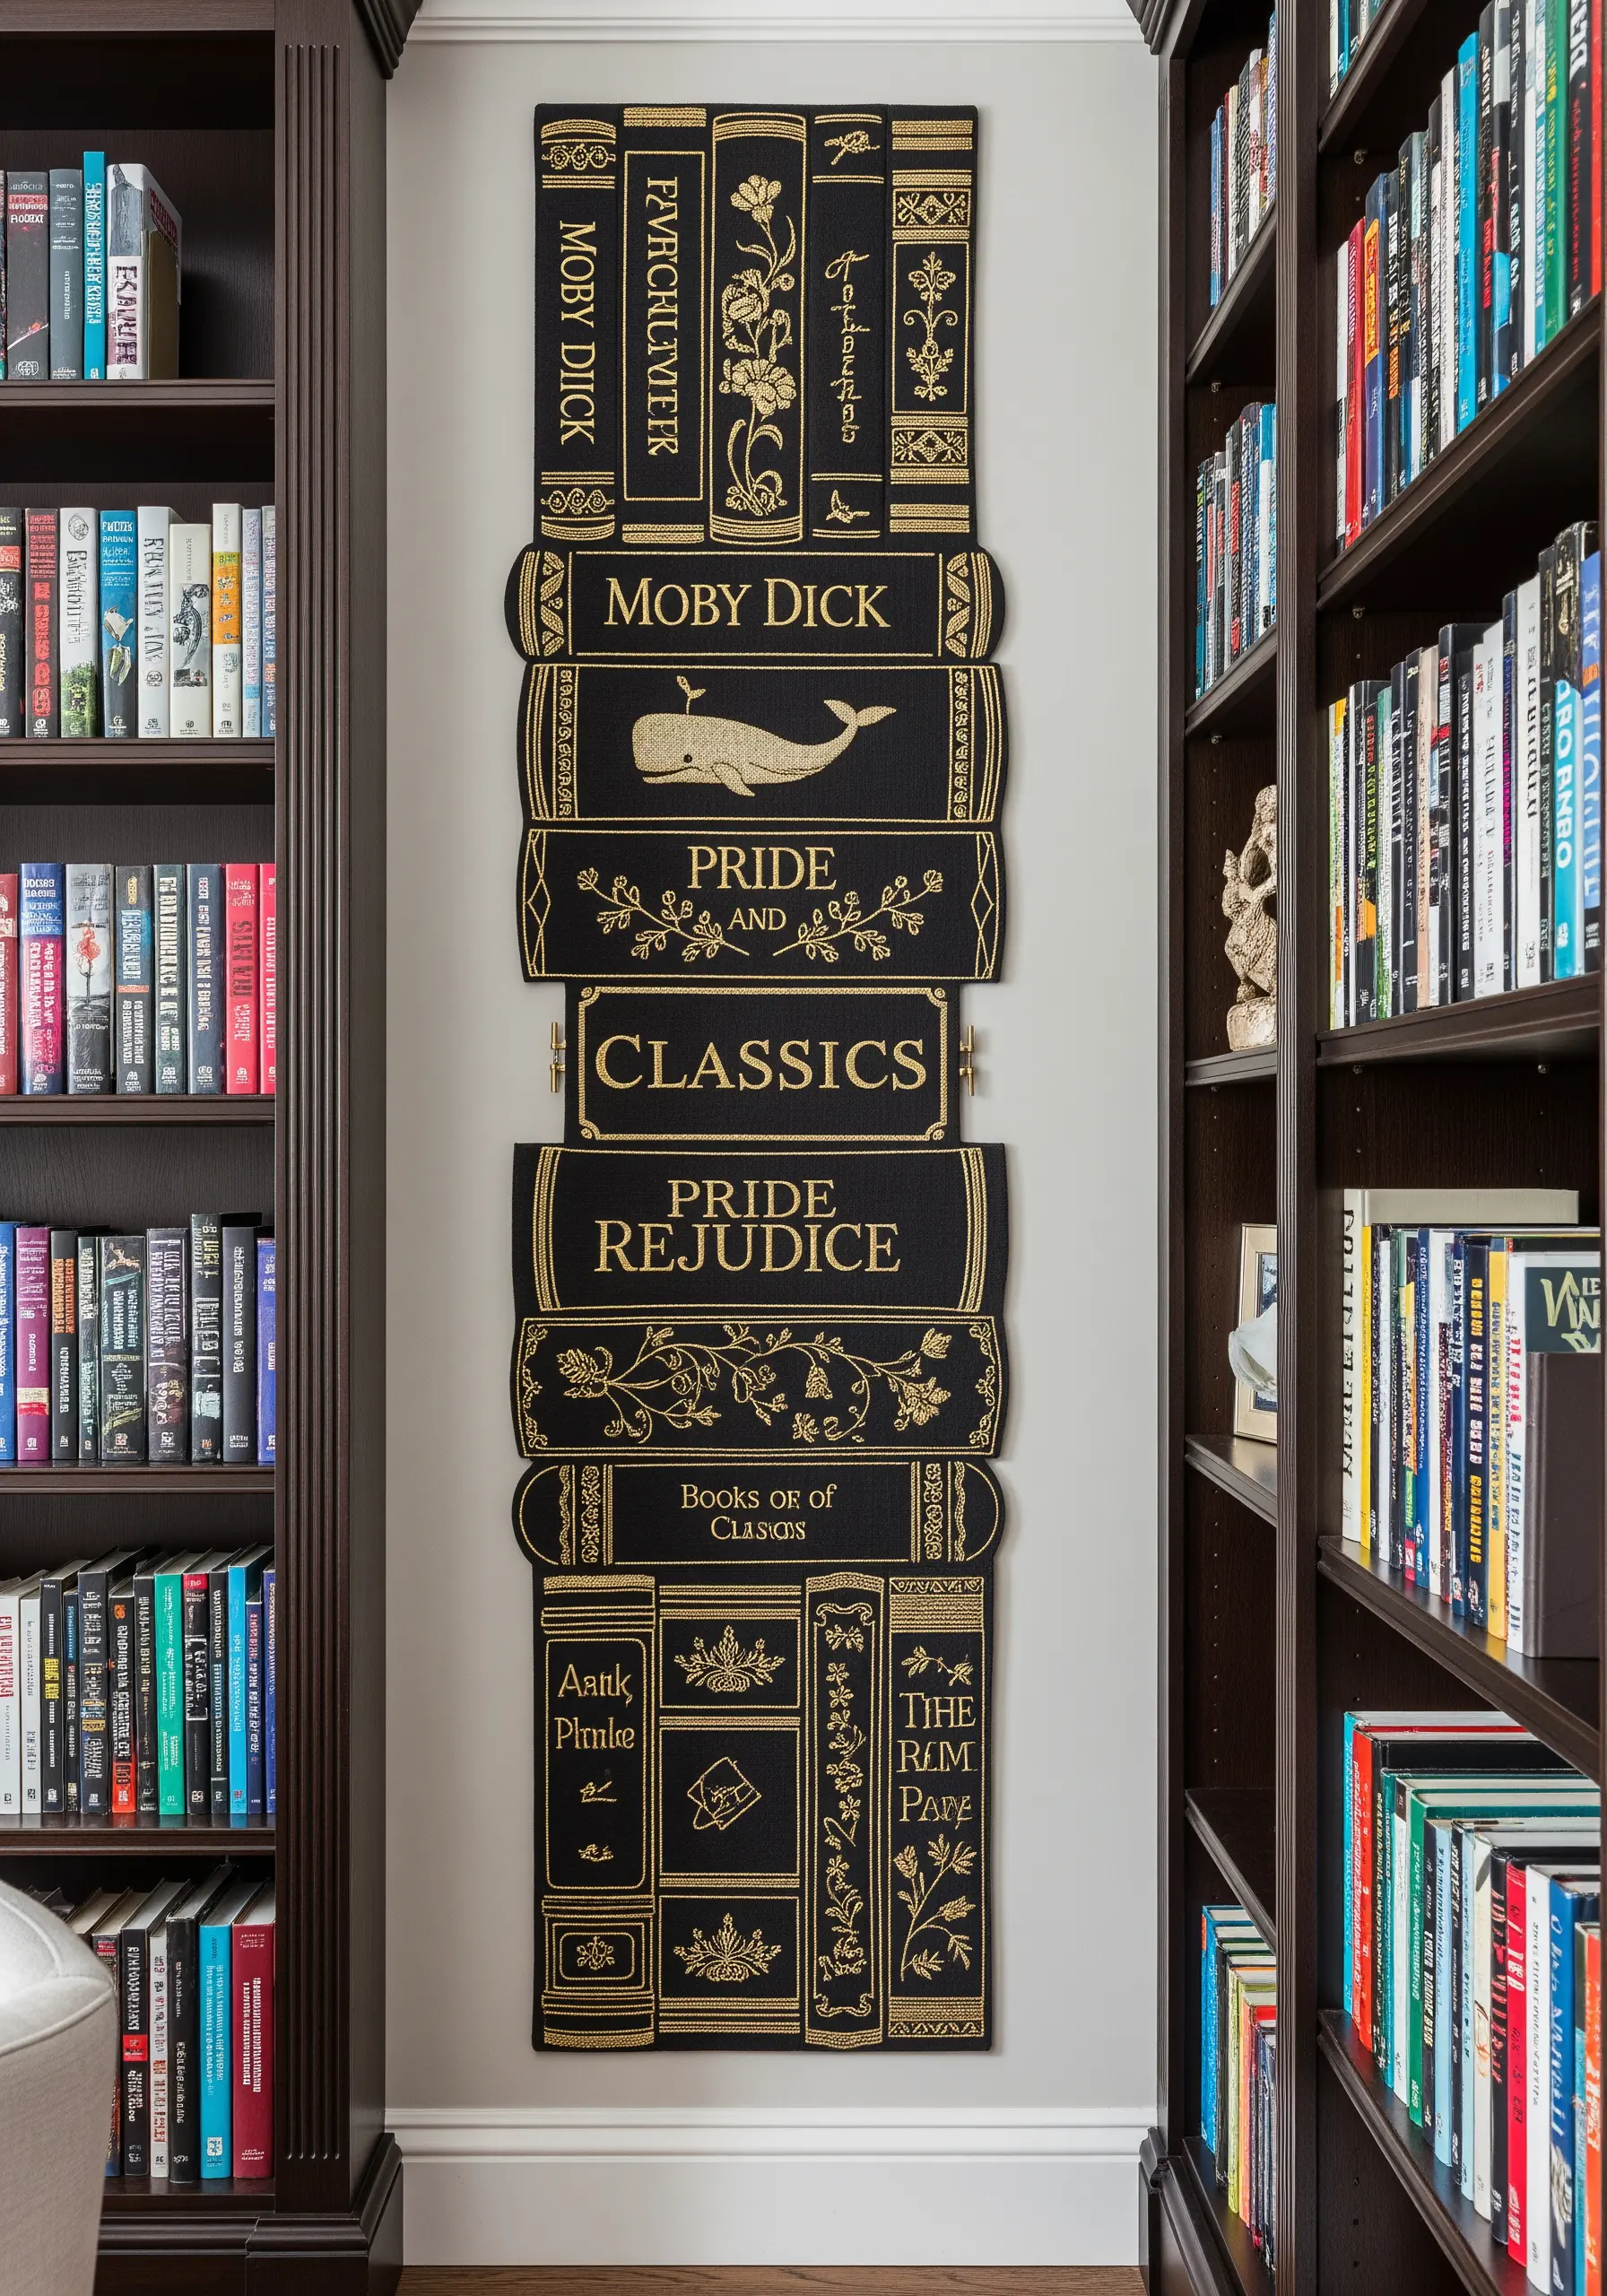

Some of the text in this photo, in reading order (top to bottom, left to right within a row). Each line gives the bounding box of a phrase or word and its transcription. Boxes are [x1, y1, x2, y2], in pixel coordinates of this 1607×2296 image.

[560, 220, 597, 328] MOBY
[604, 577, 891, 628] MOBY DICK
[687, 846, 838, 891] PRIDE
[726, 907, 787, 931] AND
[595, 1033, 927, 1091] CLASSICS
[666, 1178, 837, 1219] PRIDE
[594, 1220, 901, 1274] REJUDICE
[809, 1483, 838, 1509] of
